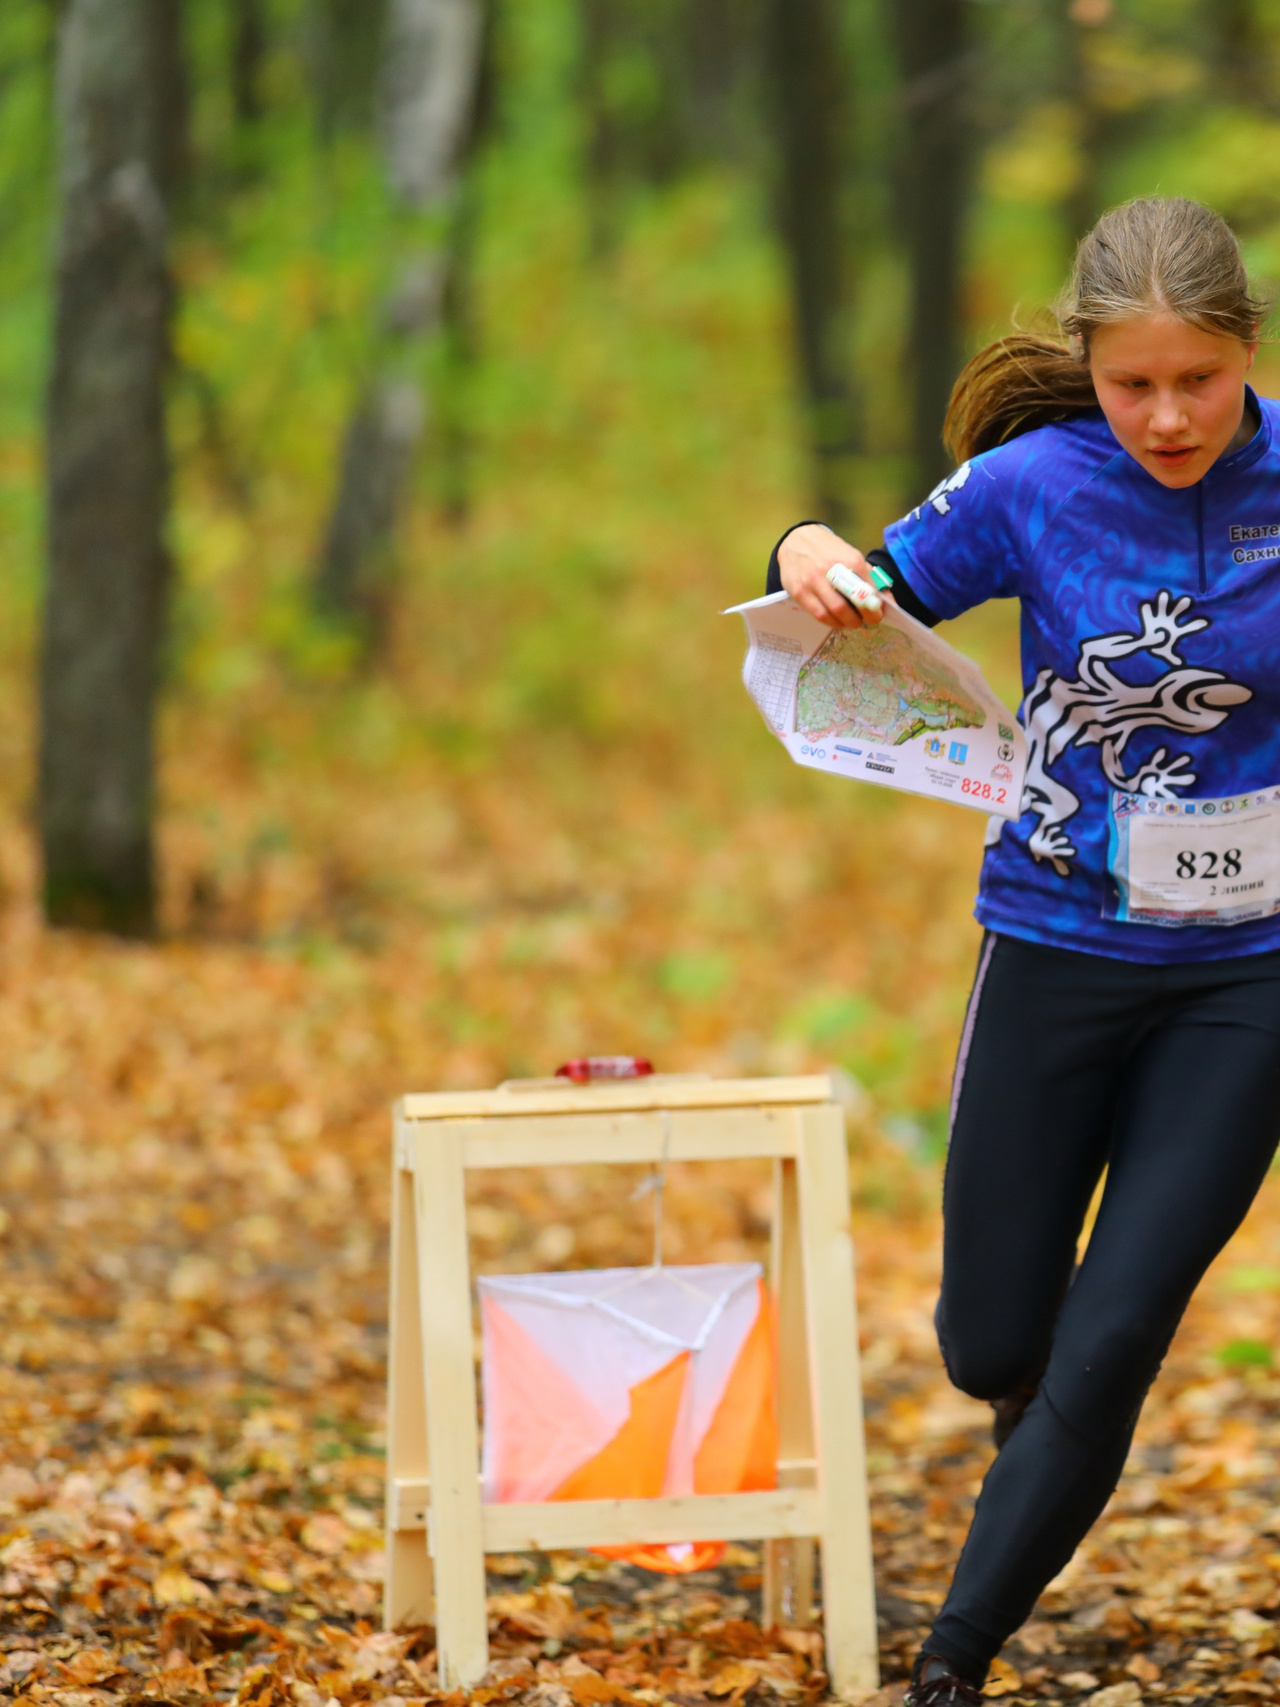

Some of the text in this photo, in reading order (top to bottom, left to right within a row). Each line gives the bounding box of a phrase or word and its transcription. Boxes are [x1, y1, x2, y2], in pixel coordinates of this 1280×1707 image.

[800, 744, 826, 759] evo
[961, 777, 1007, 803] 828.2
[1176, 848, 1242, 880] 828
[1209, 885, 1217, 896] 2
[1221, 879, 1265, 896] линия
